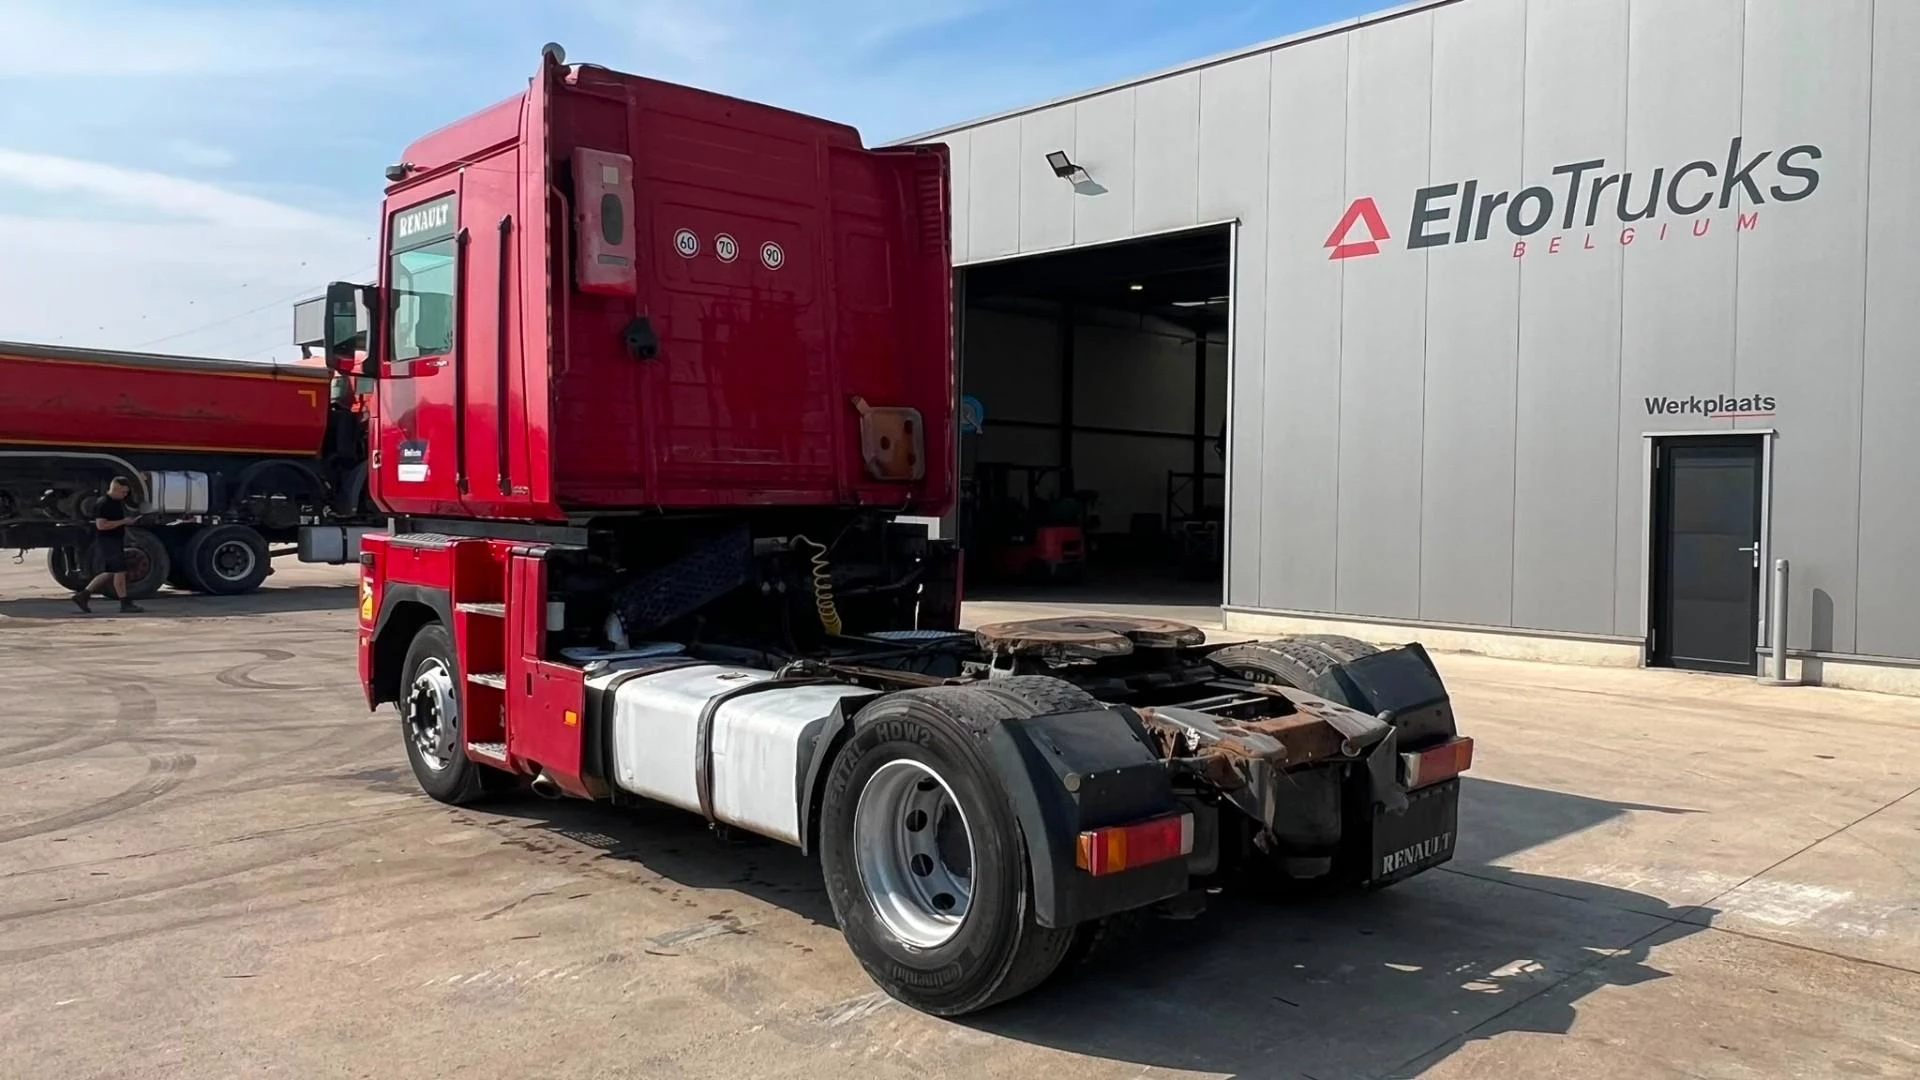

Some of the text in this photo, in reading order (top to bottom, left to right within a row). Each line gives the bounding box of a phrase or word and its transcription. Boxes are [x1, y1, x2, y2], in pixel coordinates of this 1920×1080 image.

[1407, 136, 1822, 249] ElroTrucks
[399, 203, 449, 238] RENAULT
[680, 235, 695, 251] 60
[719, 240, 733, 255] 70
[1512, 212, 1760, 259] BELGIUM
[765, 248, 779, 263] 90
[1644, 394, 1776, 417] Werkplaats
[875, 720, 931, 748] HDW2
[1382, 832, 1451, 874] RENAULT
